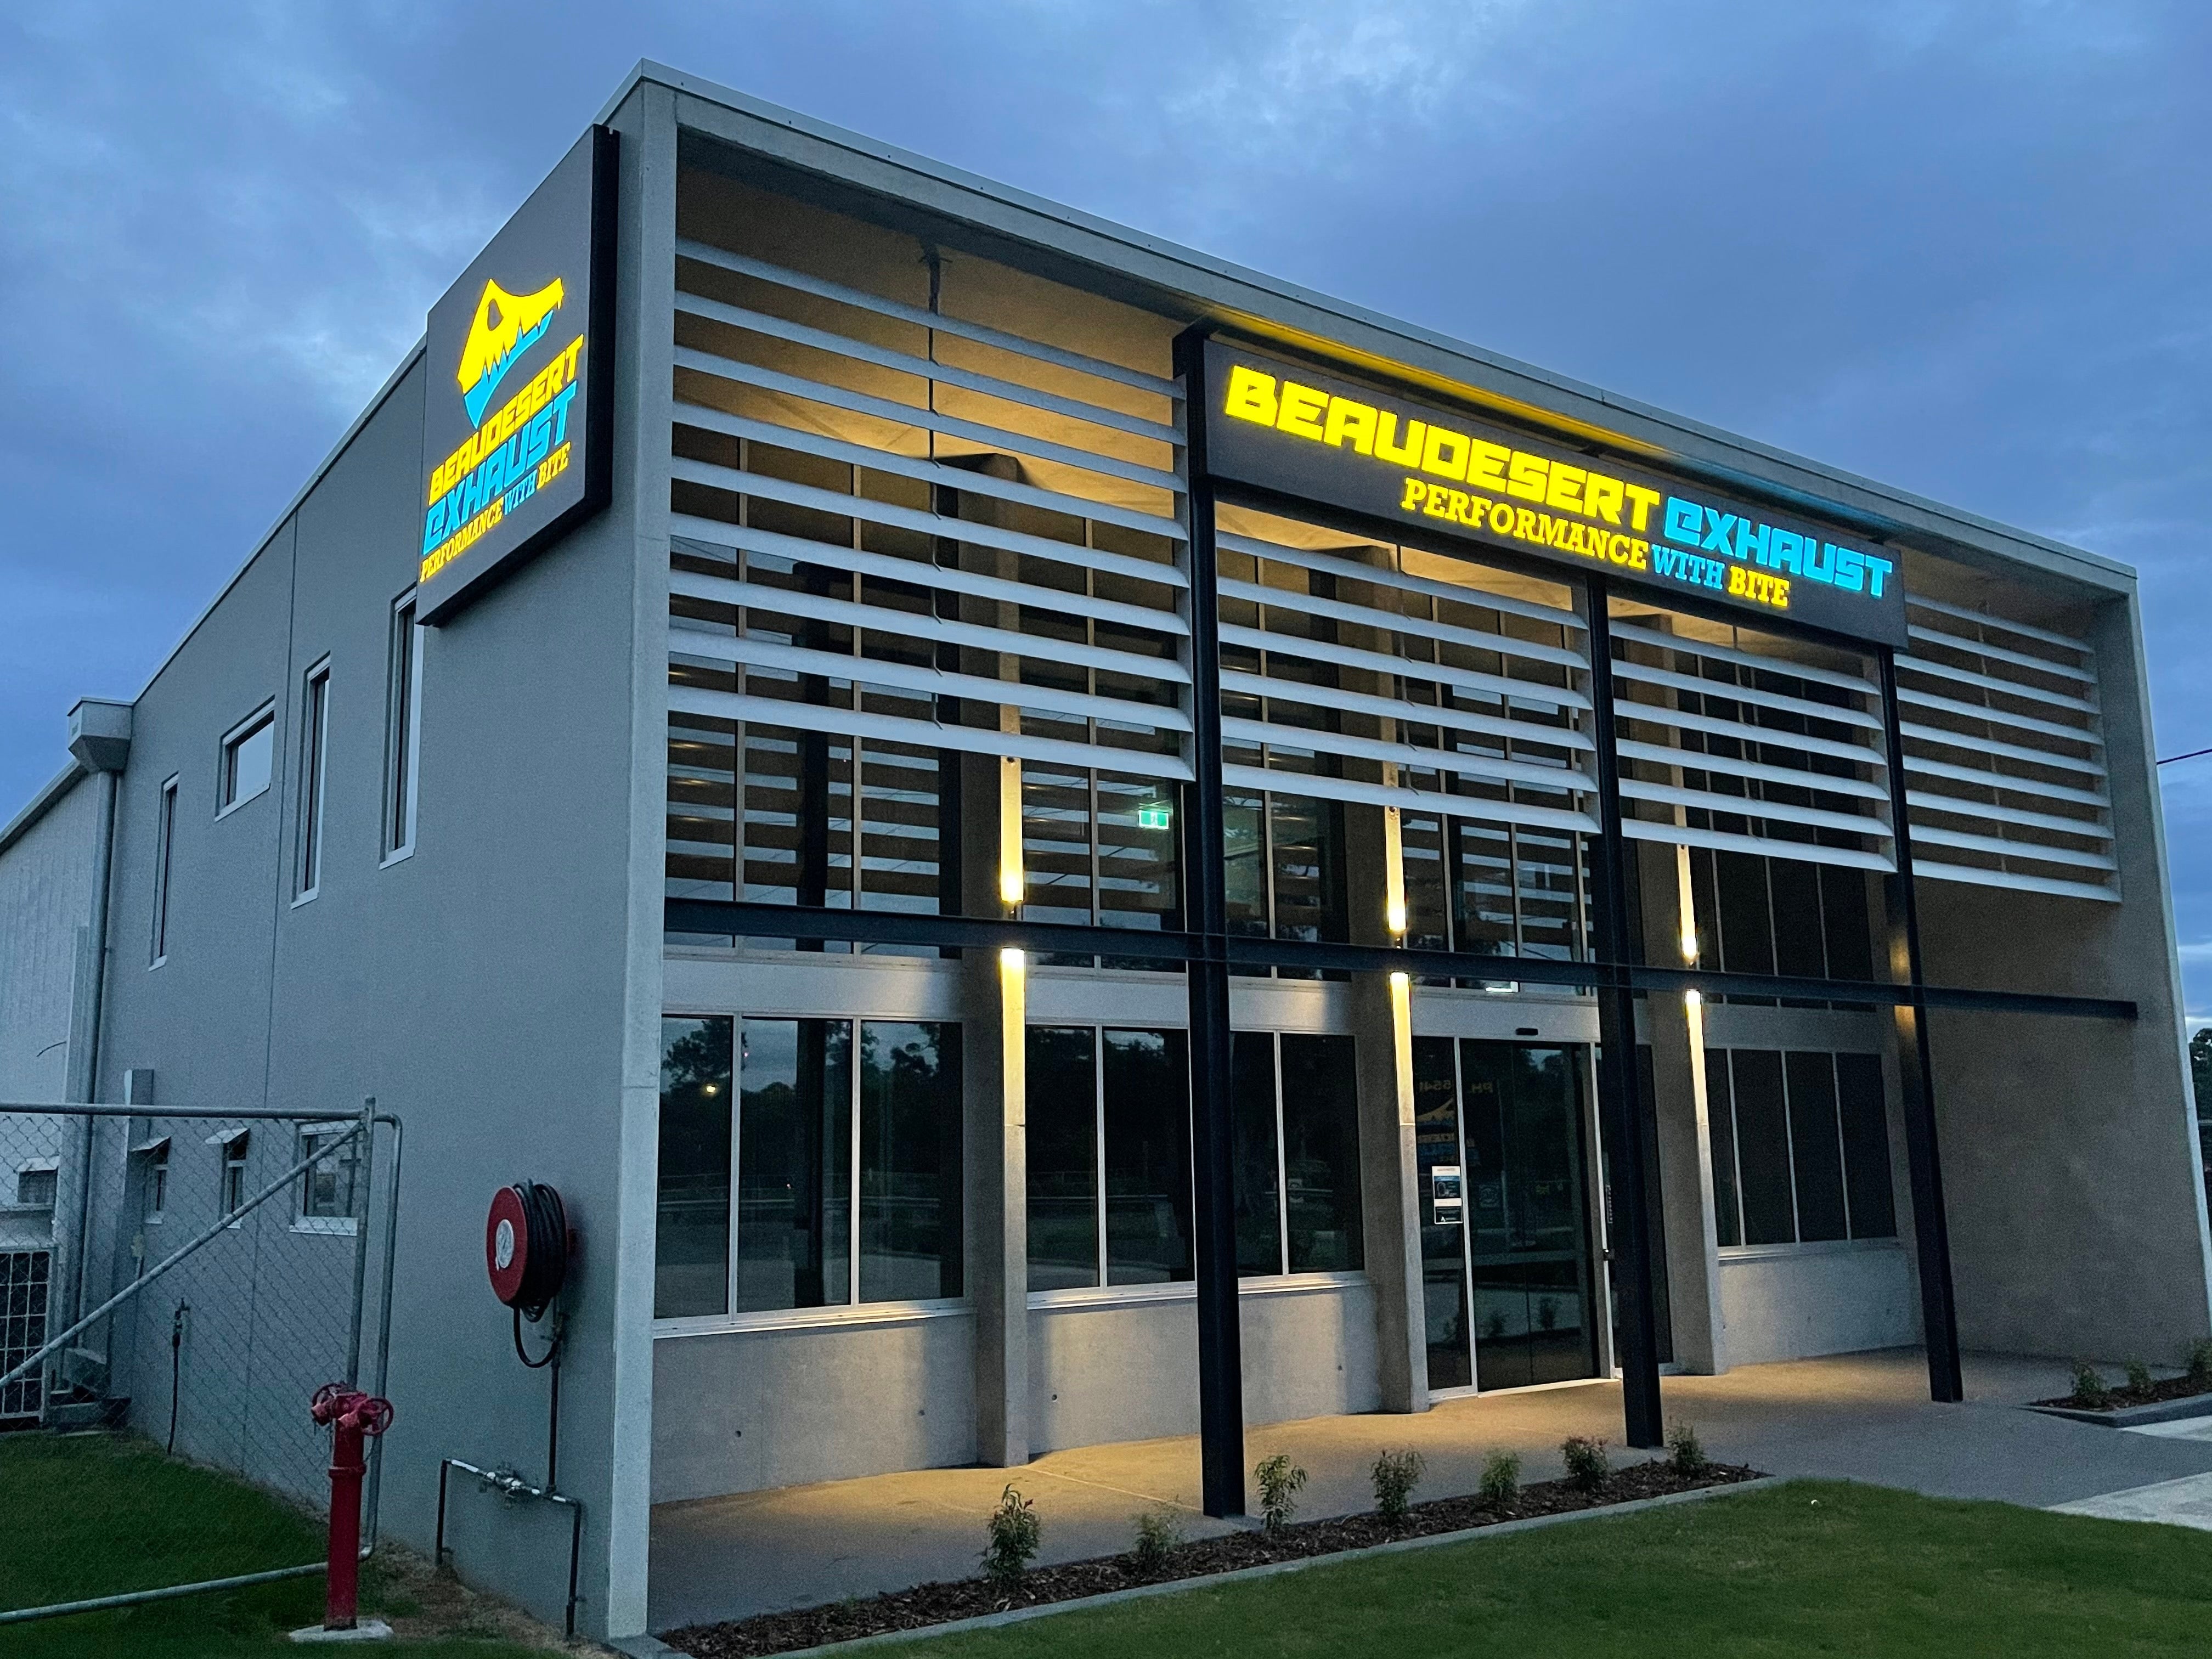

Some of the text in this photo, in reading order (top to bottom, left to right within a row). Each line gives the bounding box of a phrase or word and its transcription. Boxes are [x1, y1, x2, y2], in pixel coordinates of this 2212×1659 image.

[428, 333, 585, 506] BEAUDESERT
[1225, 365, 1661, 532] BEAUDESERT
[420, 442, 571, 583] PERFORMANCE WITH BITE
[1401, 477, 1790, 608] PERFORMANCE WITH BITE
